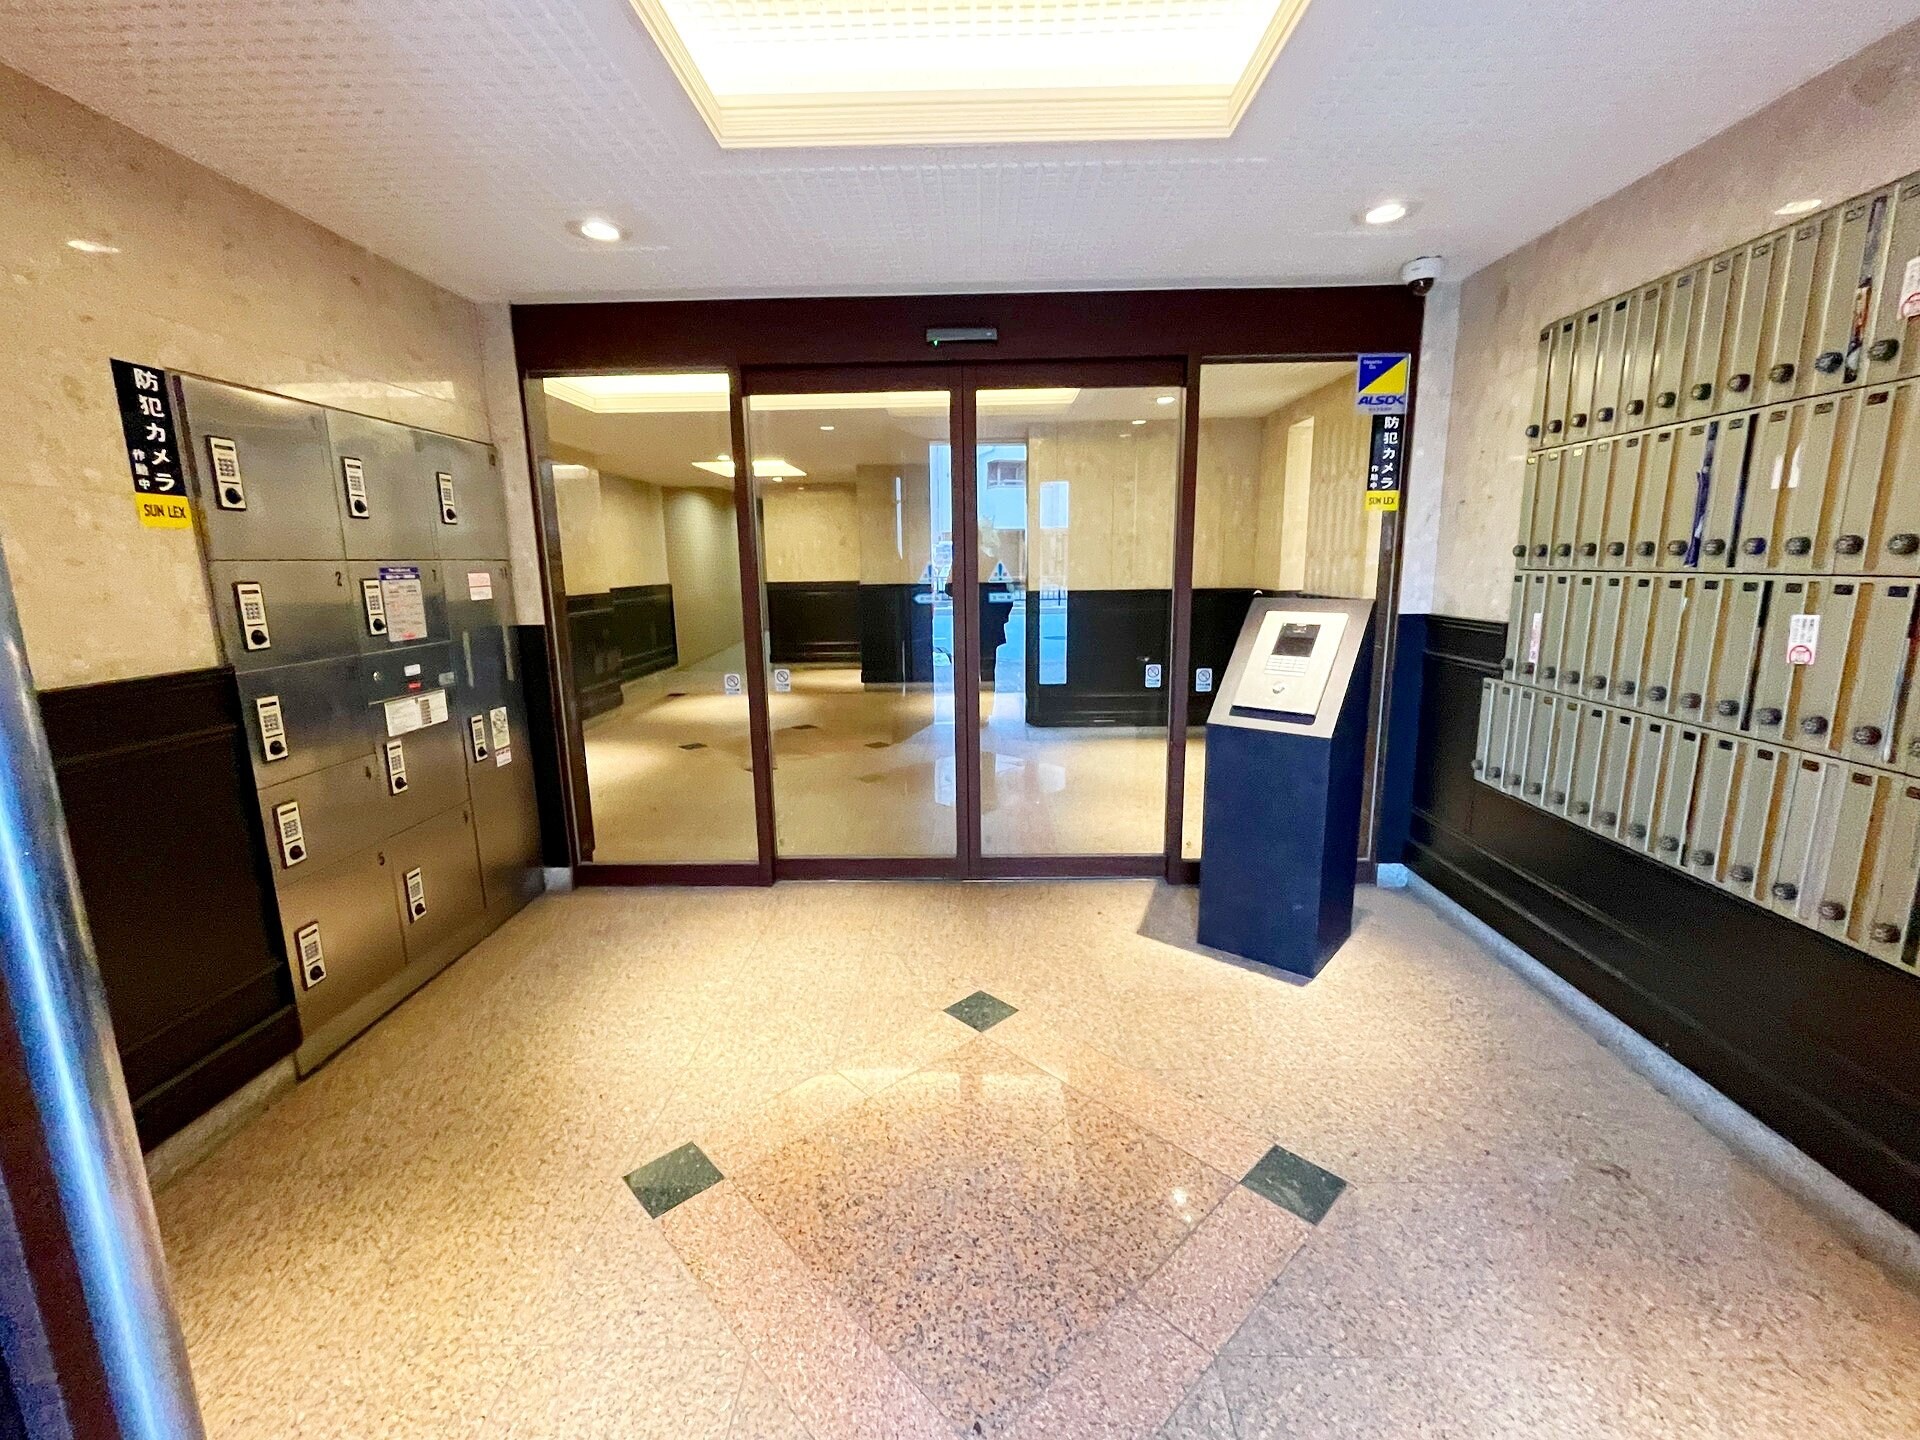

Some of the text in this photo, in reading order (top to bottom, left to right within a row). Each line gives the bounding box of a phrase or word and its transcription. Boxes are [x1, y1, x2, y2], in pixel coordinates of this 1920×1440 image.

[1358, 395, 1404, 406] ALSOK
[133, 367, 175, 492] 防犯カメラ
[1381, 416, 1400, 490] 防犯カメラ
[1368, 497, 1395, 506] SUN LEX
[144, 503, 186, 519] SUN LEX
[334, 571, 342, 587] 2
